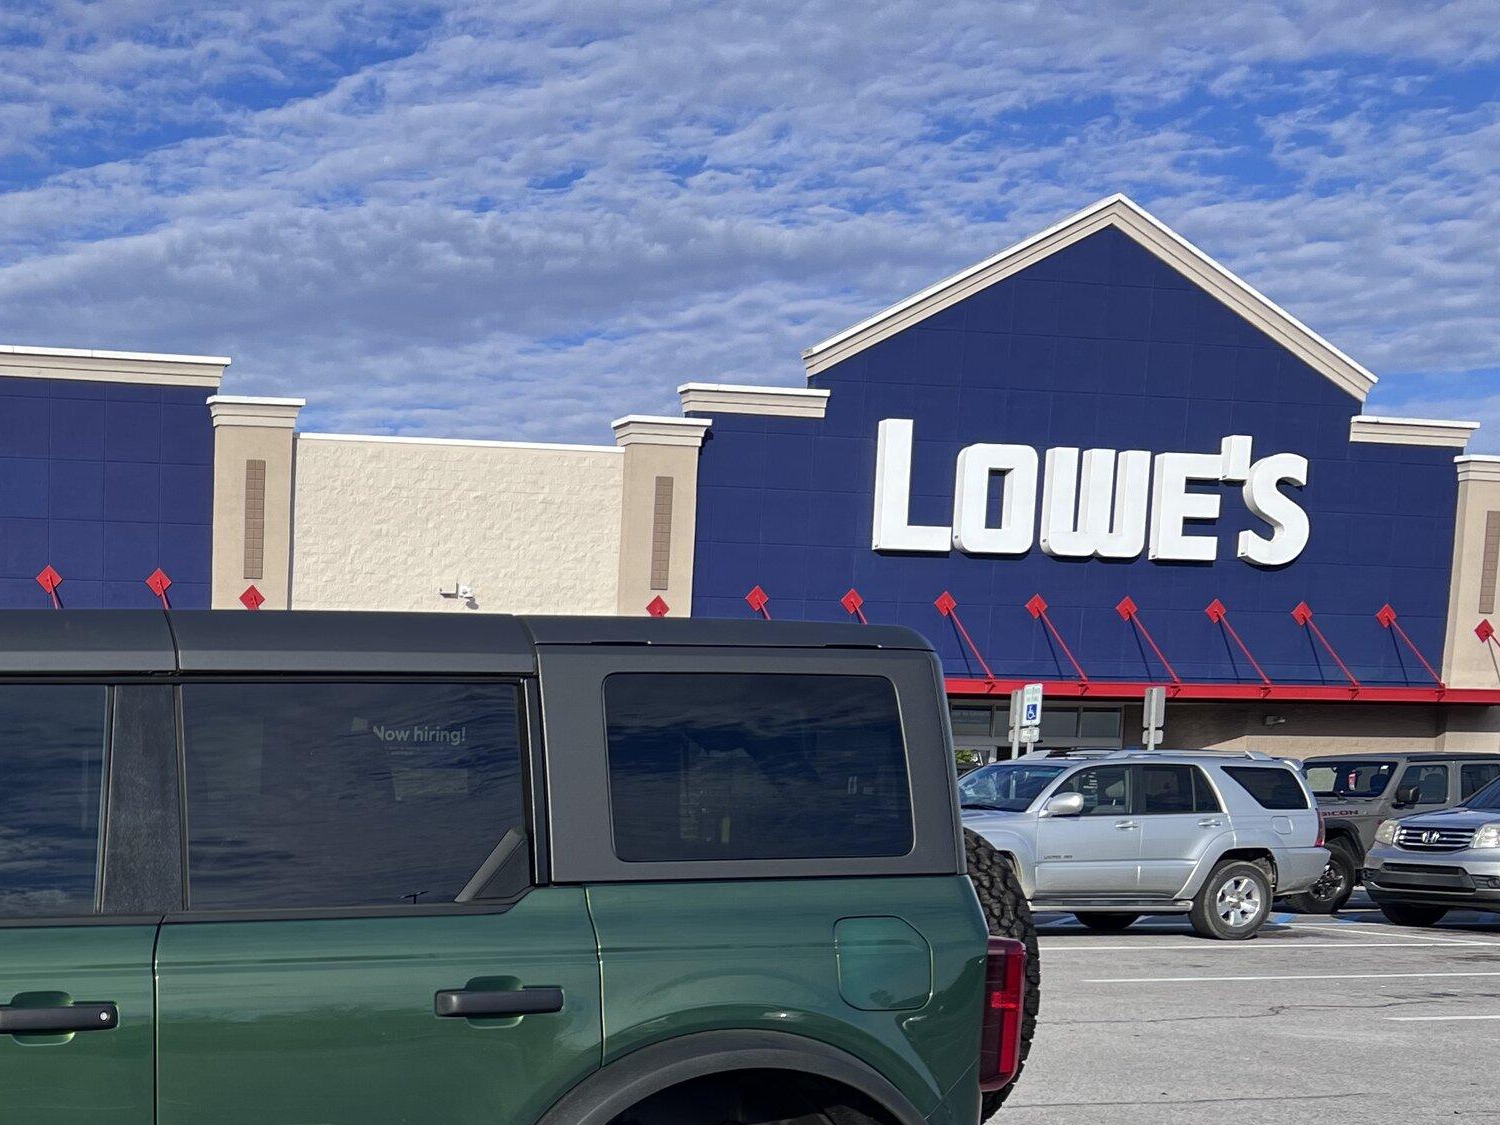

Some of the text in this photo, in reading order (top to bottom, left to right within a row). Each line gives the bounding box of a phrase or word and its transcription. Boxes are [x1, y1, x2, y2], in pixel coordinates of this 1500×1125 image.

[872, 418, 1310, 566] LOWE'S
[372, 726, 466, 746] Now hiring!
